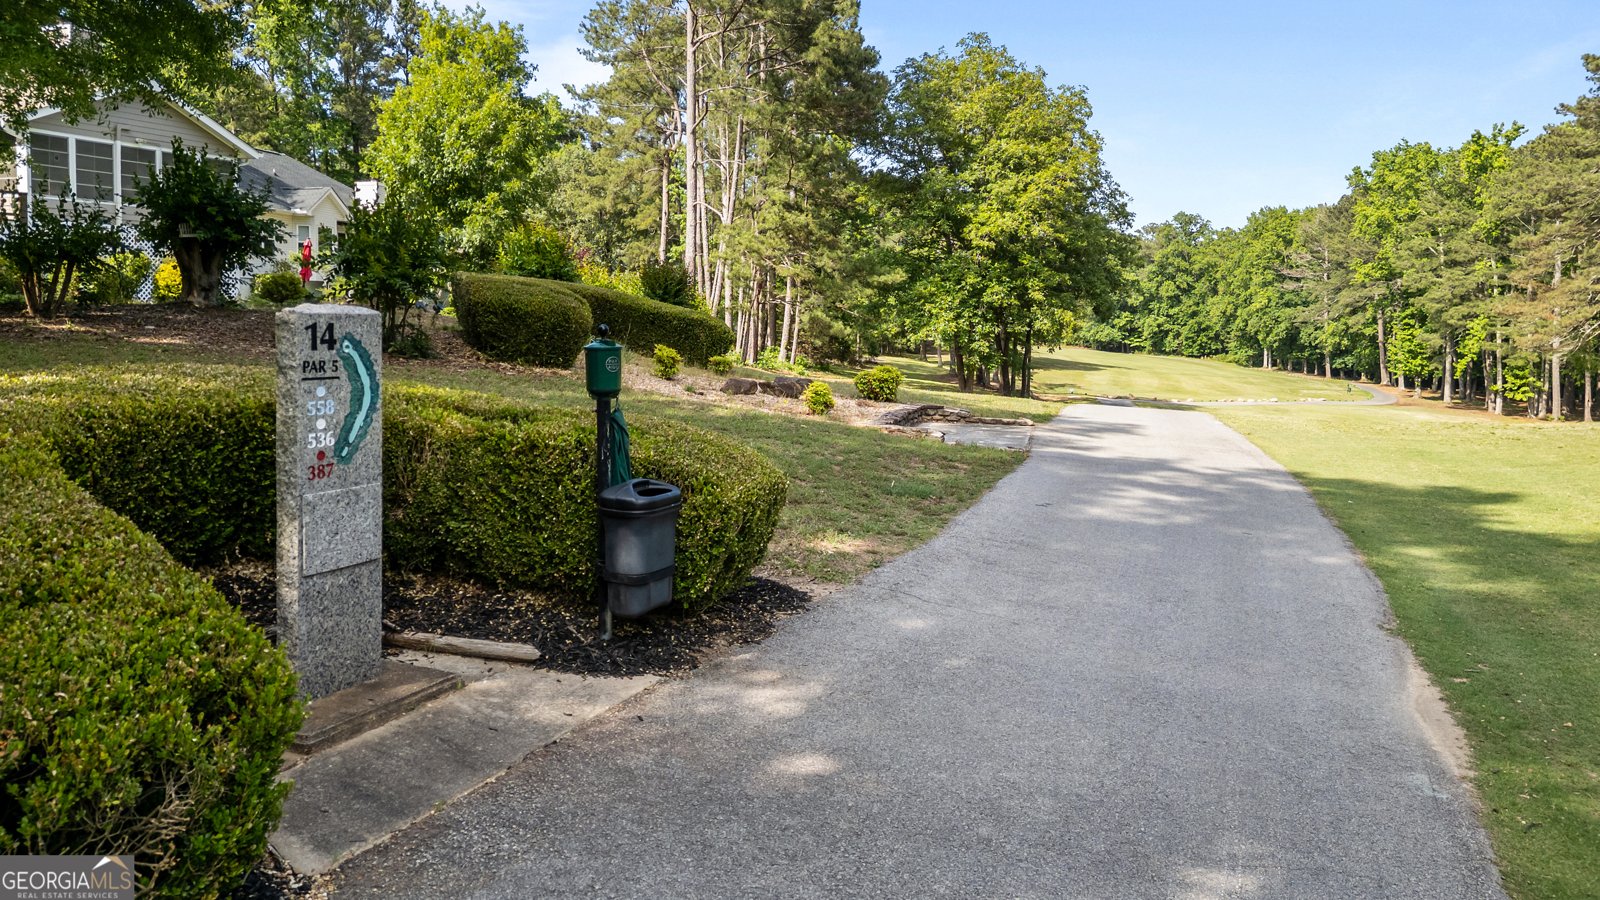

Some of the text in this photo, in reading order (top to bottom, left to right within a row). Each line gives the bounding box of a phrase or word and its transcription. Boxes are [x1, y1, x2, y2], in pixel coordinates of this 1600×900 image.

[304, 322, 337, 351] 14
[302, 360, 339, 374] PAR 5
[307, 400, 335, 416] 558
[307, 431, 335, 449] 536
[307, 463, 335, 481] 387
